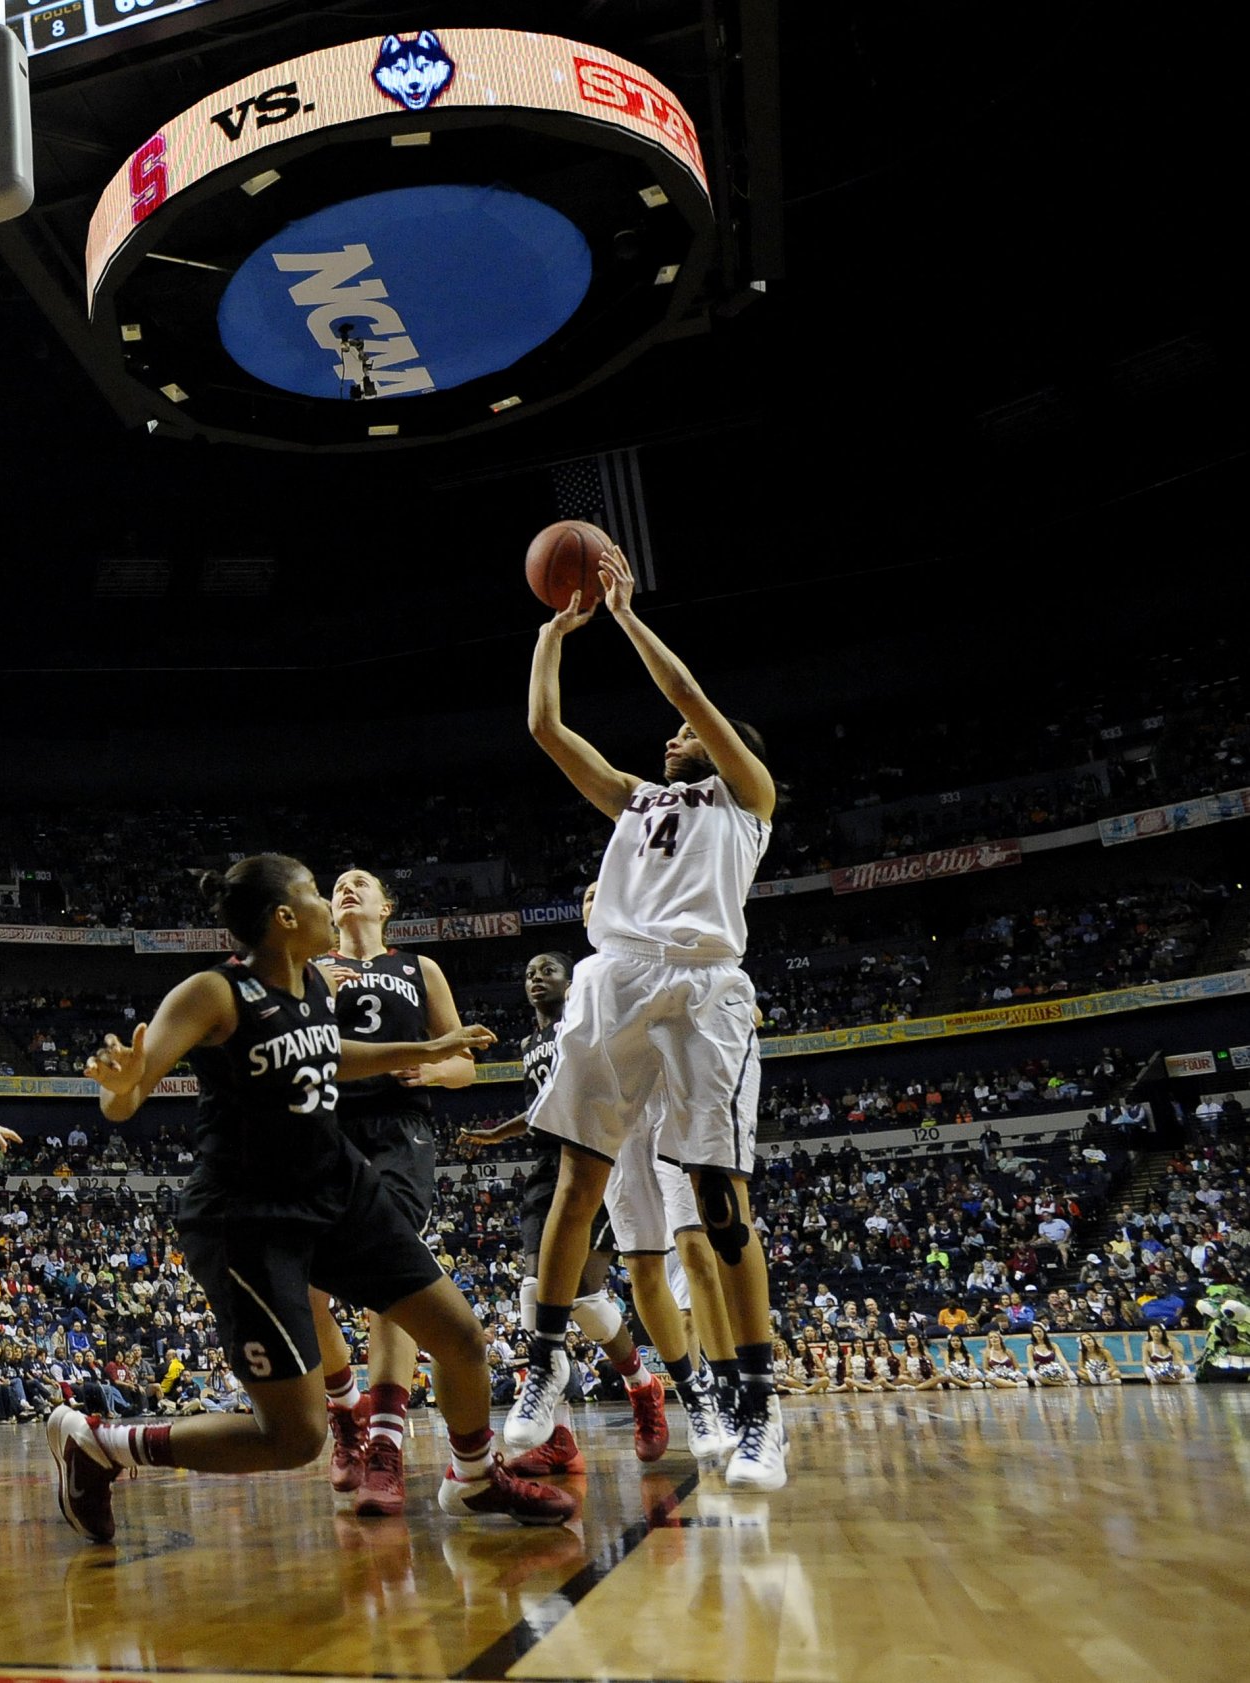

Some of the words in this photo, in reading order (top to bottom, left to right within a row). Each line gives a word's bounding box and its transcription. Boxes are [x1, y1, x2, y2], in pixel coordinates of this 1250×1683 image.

[33, 2, 82, 23] FOULS
[52, 19, 66, 38] 8
[129, 133, 167, 223] S
[211, 82, 315, 142] VS.
[272, 243, 435, 400] NCAA
[637, 812, 681, 857] 14
[848, 859, 924, 889] Music
[925, 849, 978, 877] City
[522, 904, 582, 924] UCONN
[786, 956, 810, 970] 224
[354, 994, 382, 1034] 3
[1006, 1004, 1062, 1024] AWAITS
[249, 1024, 341, 1077] STANFO
[181, 1079, 200, 1094] FOU
[912, 1126, 940, 1142] 120
[478, 1164, 498, 1178] 101
[243, 1341, 272, 1378] S
